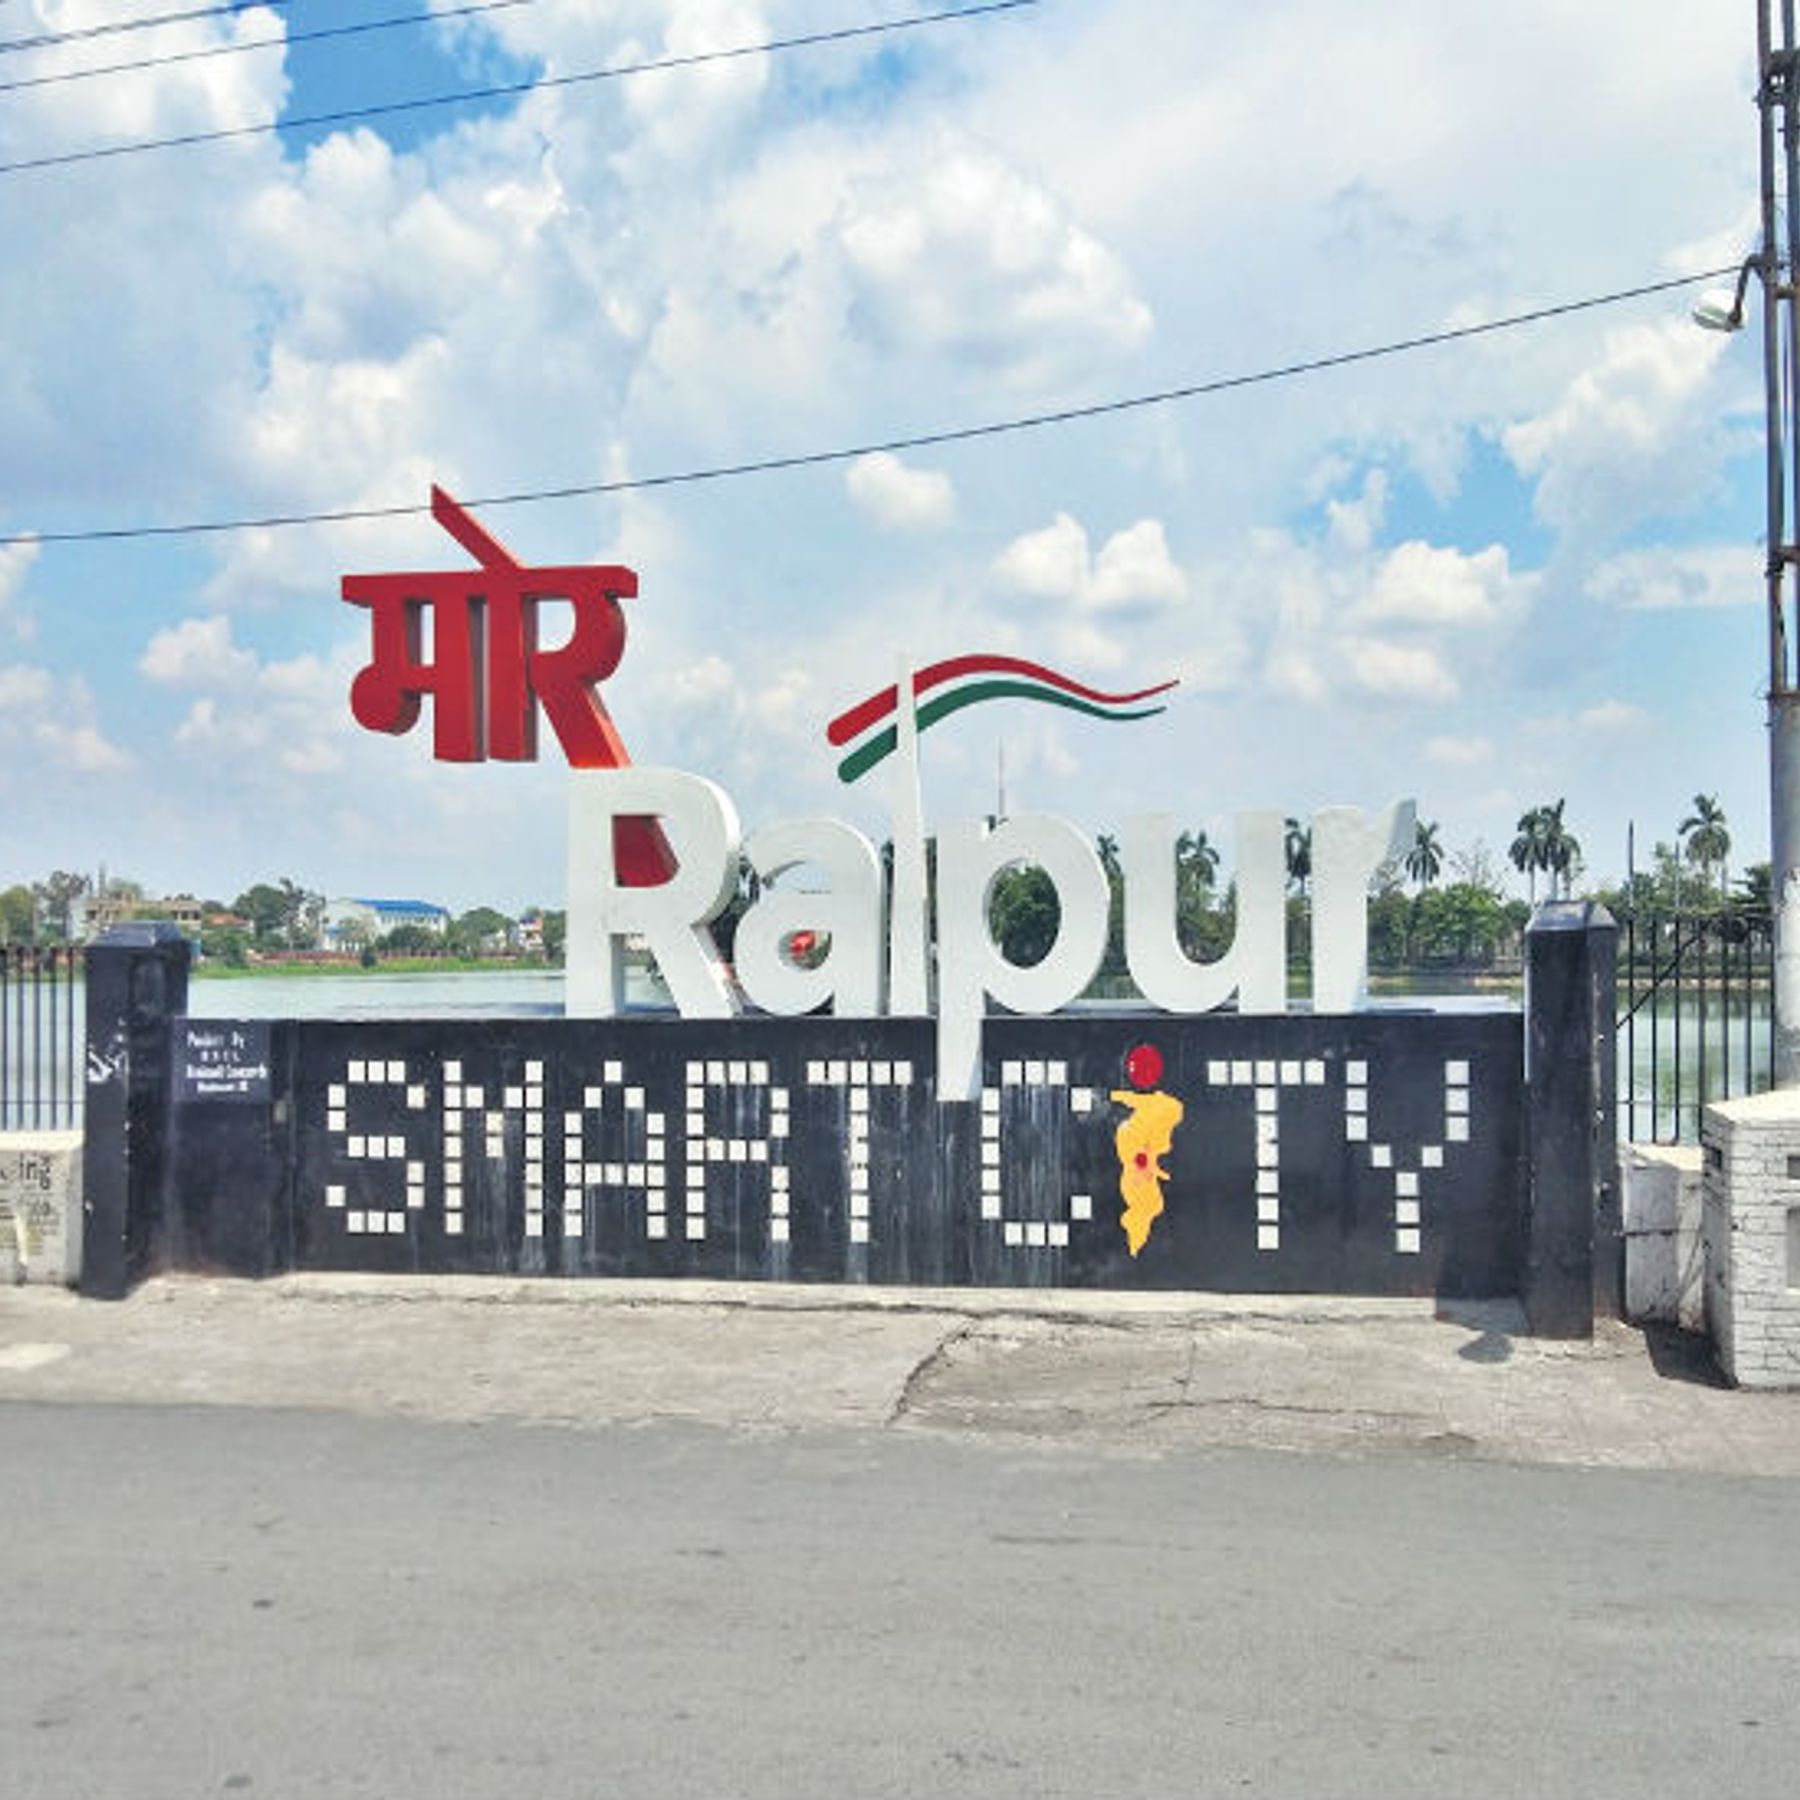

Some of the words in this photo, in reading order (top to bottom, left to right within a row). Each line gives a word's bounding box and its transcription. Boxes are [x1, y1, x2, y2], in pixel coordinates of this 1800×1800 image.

[341, 483, 639, 769] मोर
[565, 653, 1418, 1102] Raipur
[326, 1061, 913, 1243] SMART
